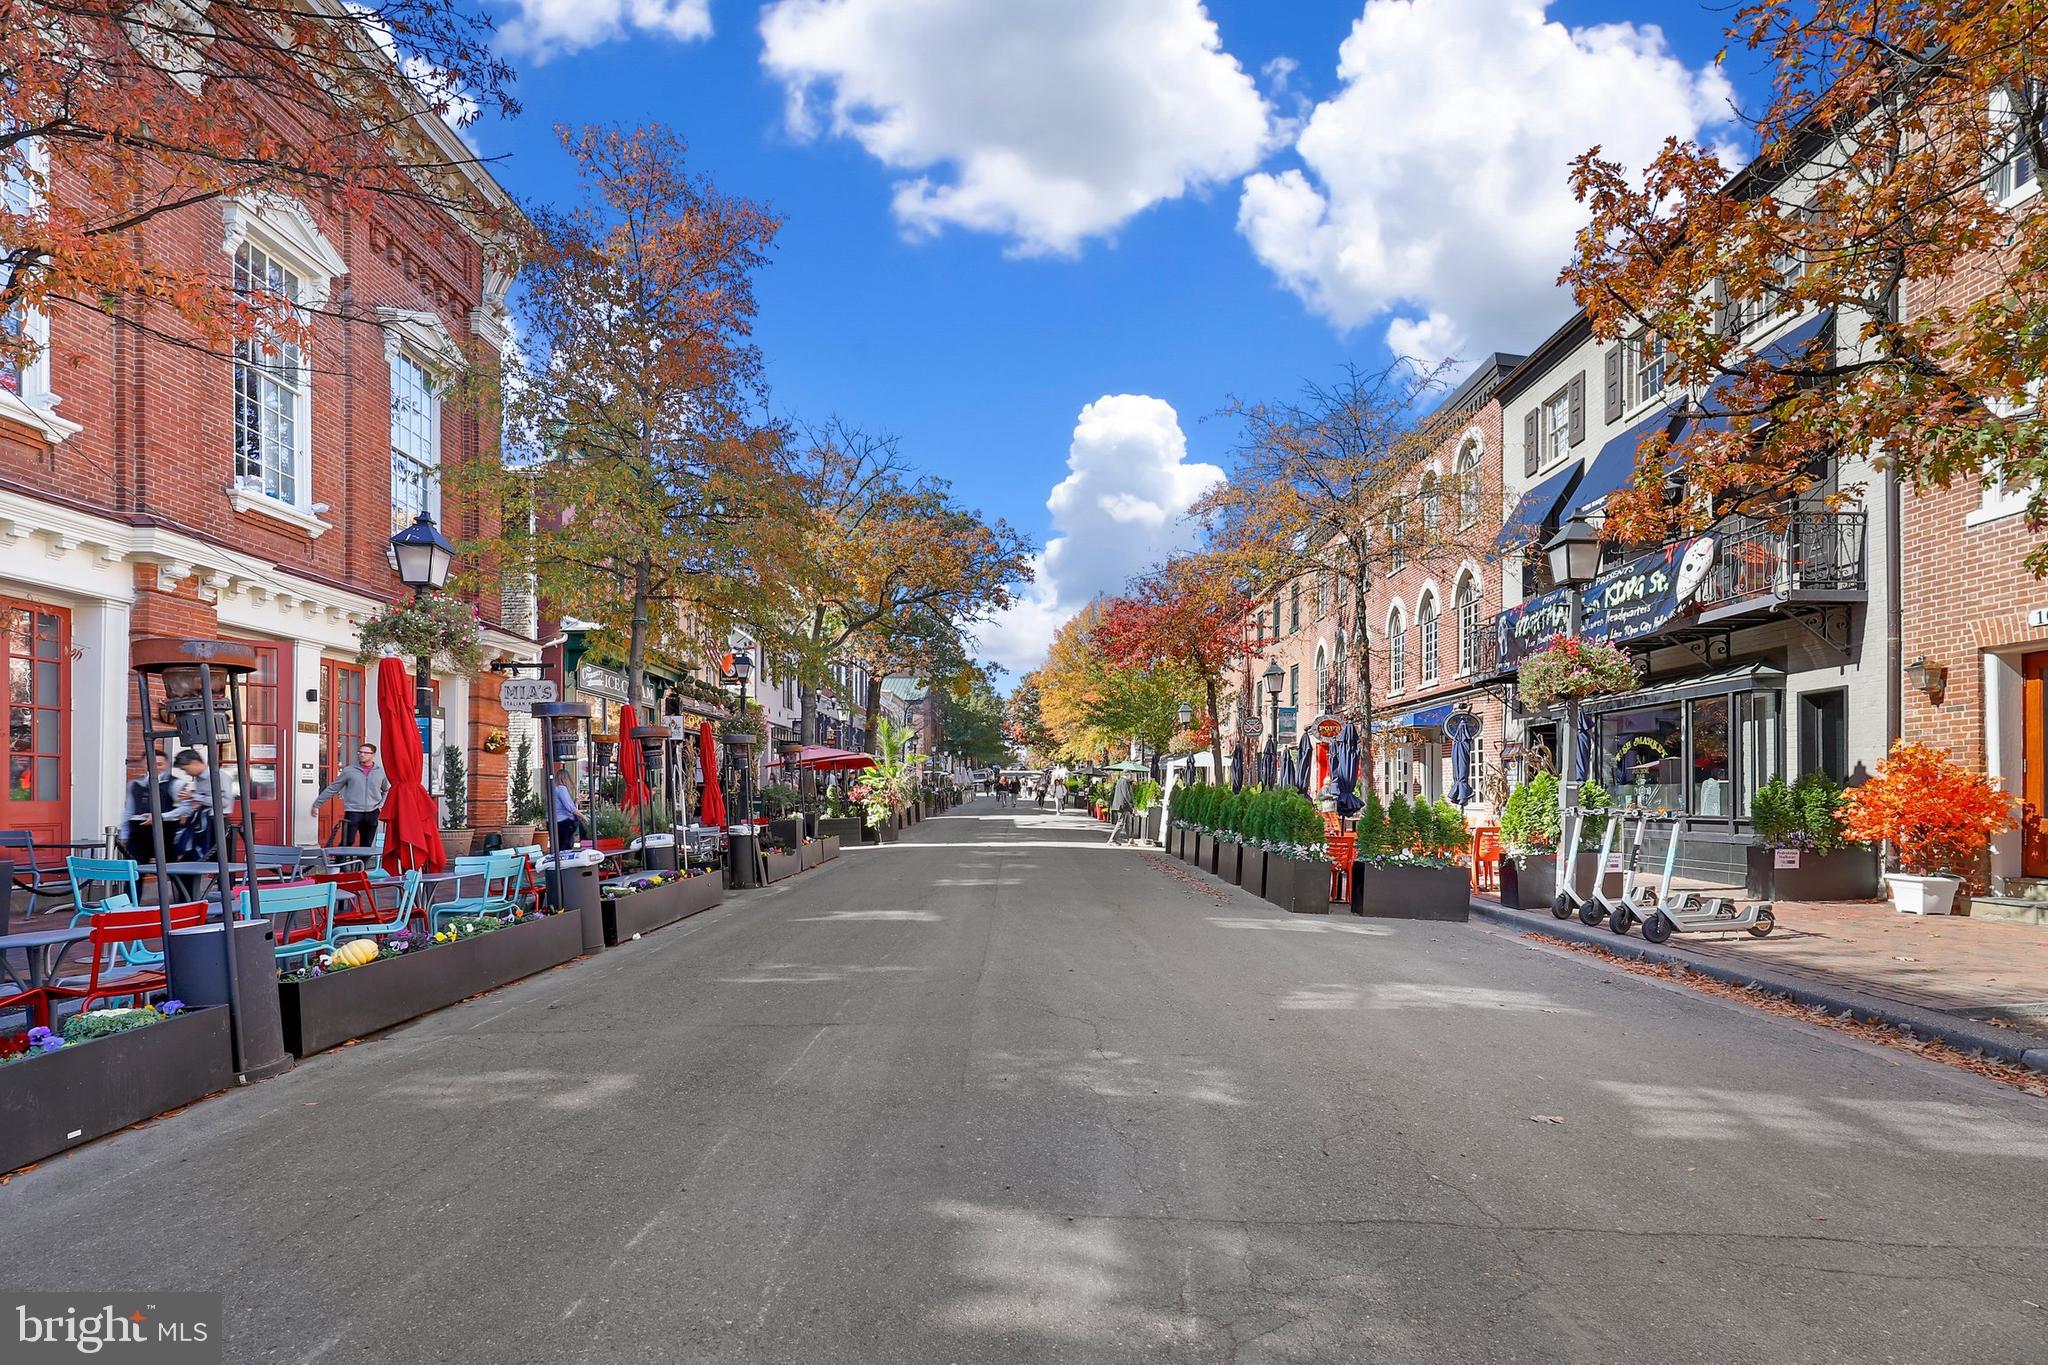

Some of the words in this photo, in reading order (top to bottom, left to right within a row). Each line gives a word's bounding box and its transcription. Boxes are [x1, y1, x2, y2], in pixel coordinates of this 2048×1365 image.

[1595, 564, 1635, 587] PRESENTS
[1604, 575, 1646, 608] KING
[1648, 569, 1669, 593] St.
[1605, 604, 1651, 625] Headquarters
[503, 684, 552, 700] MIA'S
[604, 674, 621, 692] ICE
[621, 679, 654, 700] CAM
[1615, 740, 1632, 762] FISH
[1633, 736, 1669, 759] MARKET
